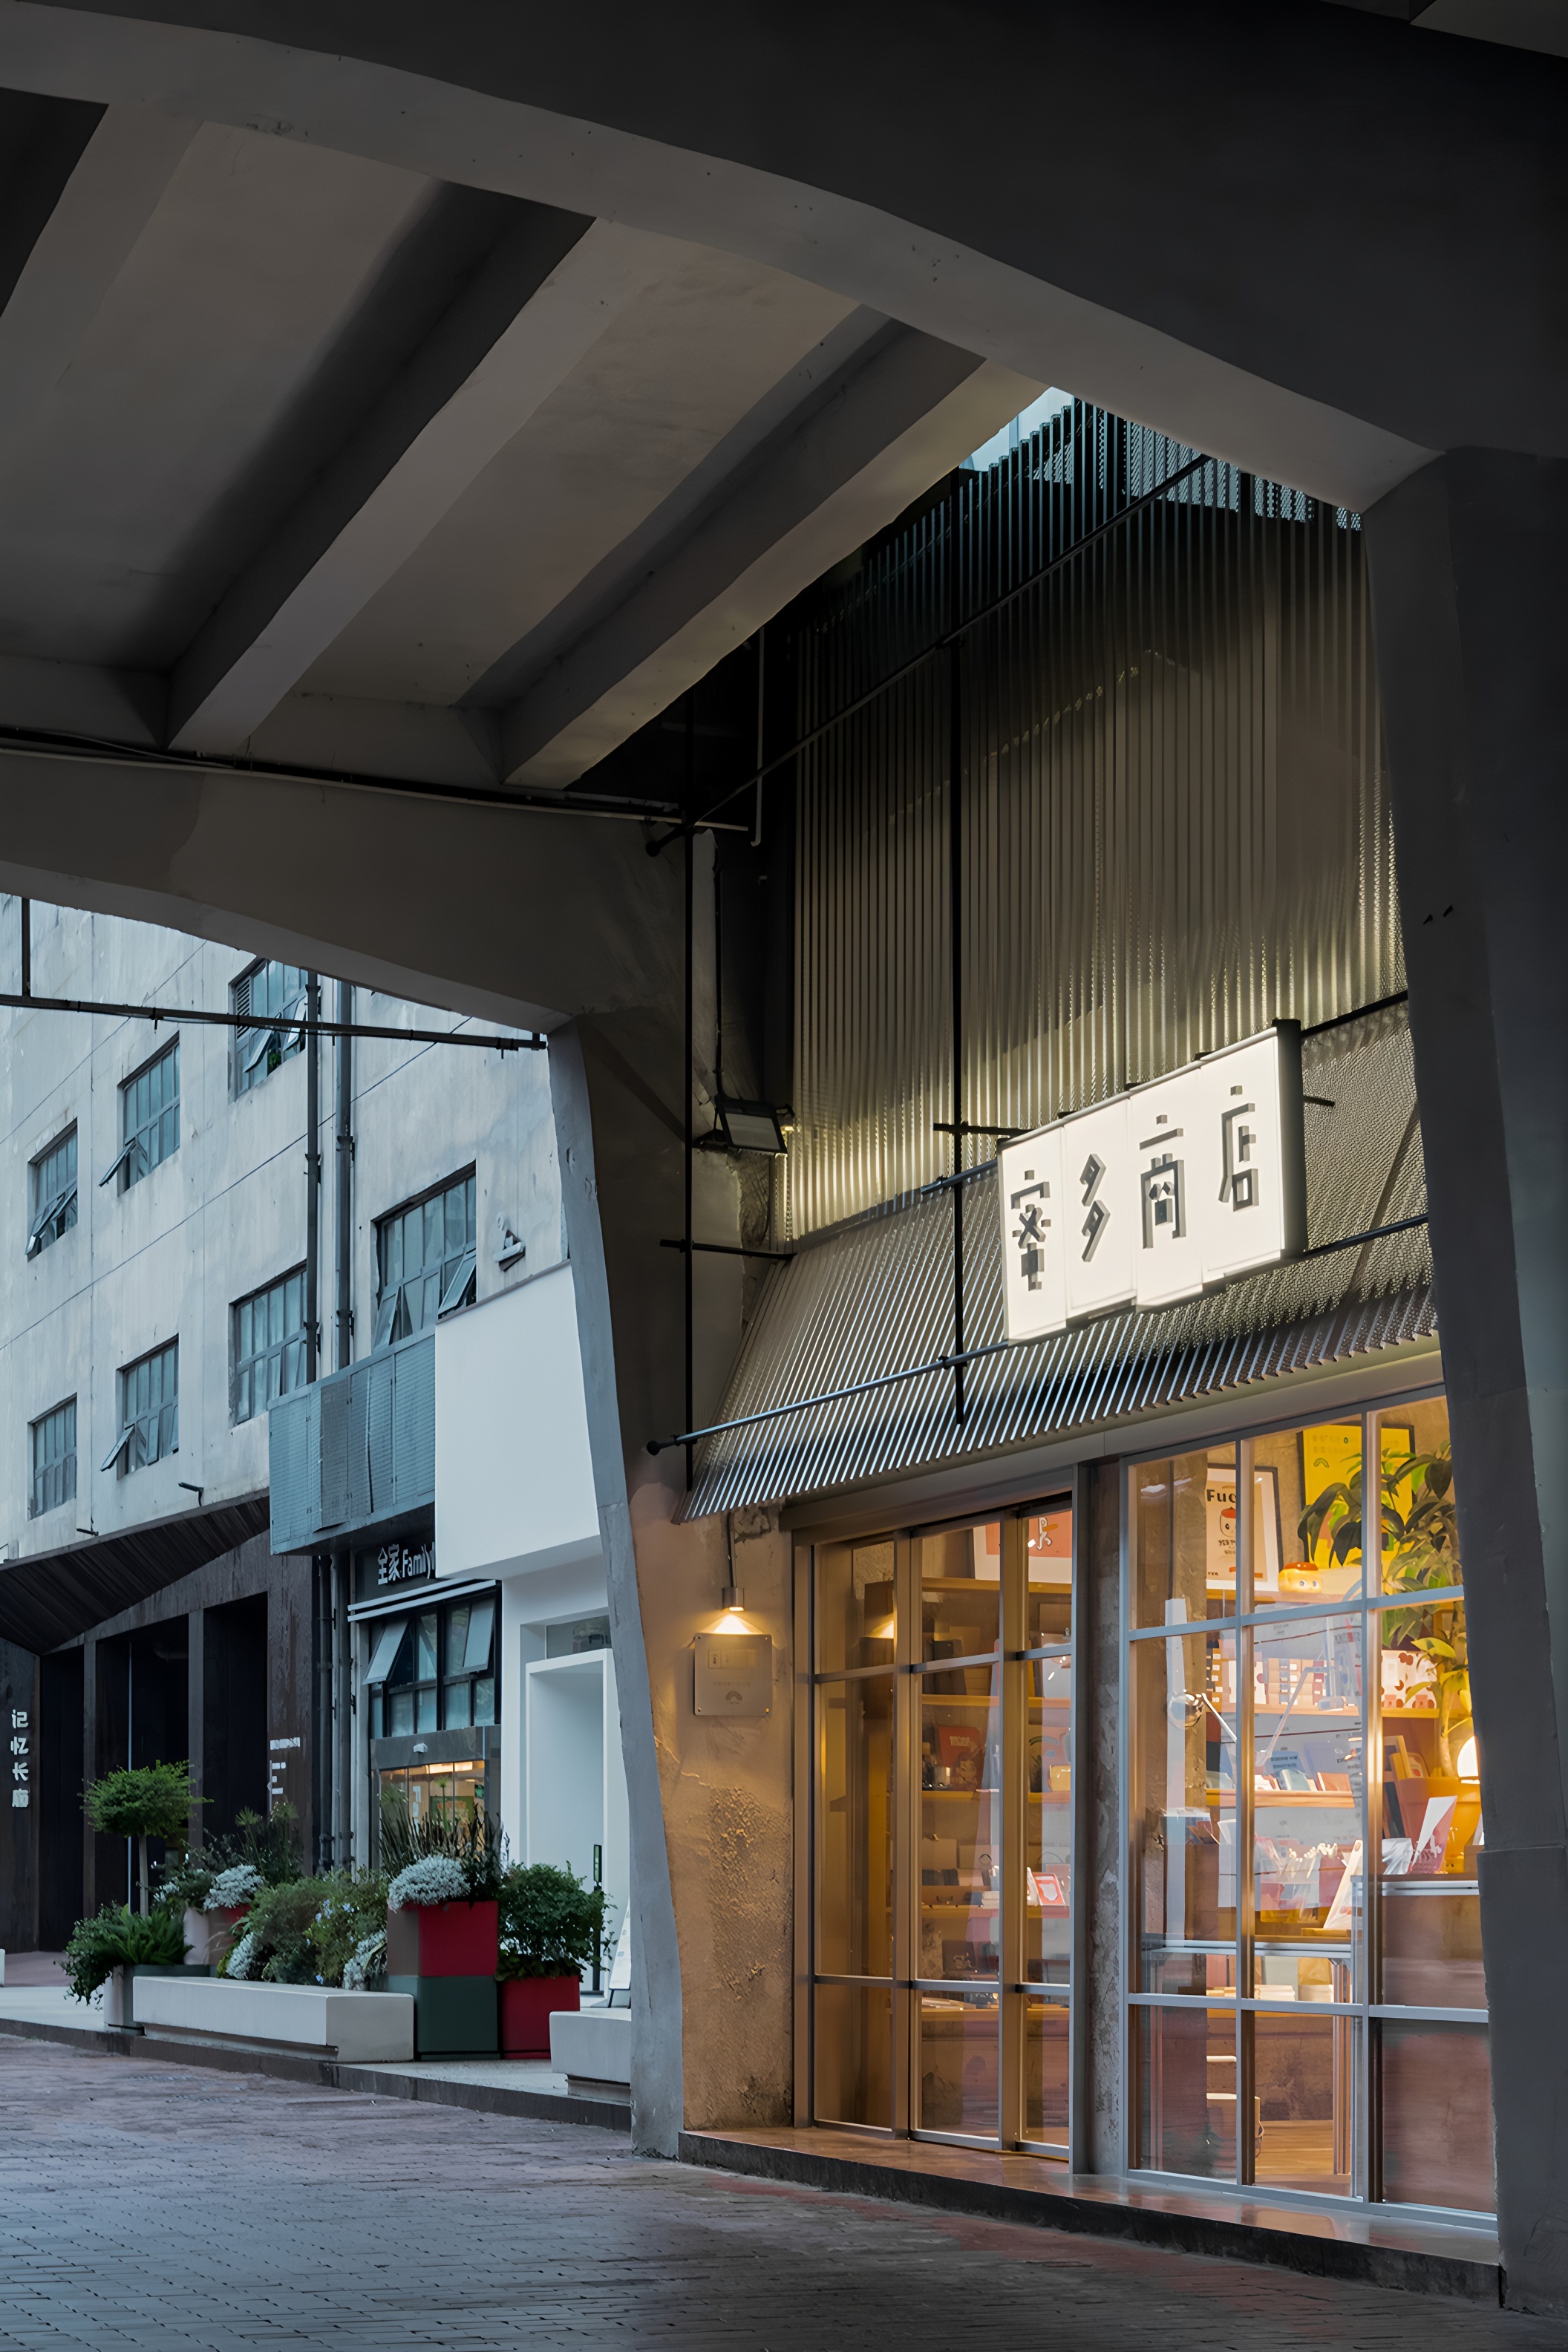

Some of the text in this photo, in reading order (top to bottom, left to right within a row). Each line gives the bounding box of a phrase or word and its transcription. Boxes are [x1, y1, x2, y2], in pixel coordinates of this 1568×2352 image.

[1010, 1085, 1260, 1292] 蜜多商店
[377, 1544, 402, 1586] 全家
